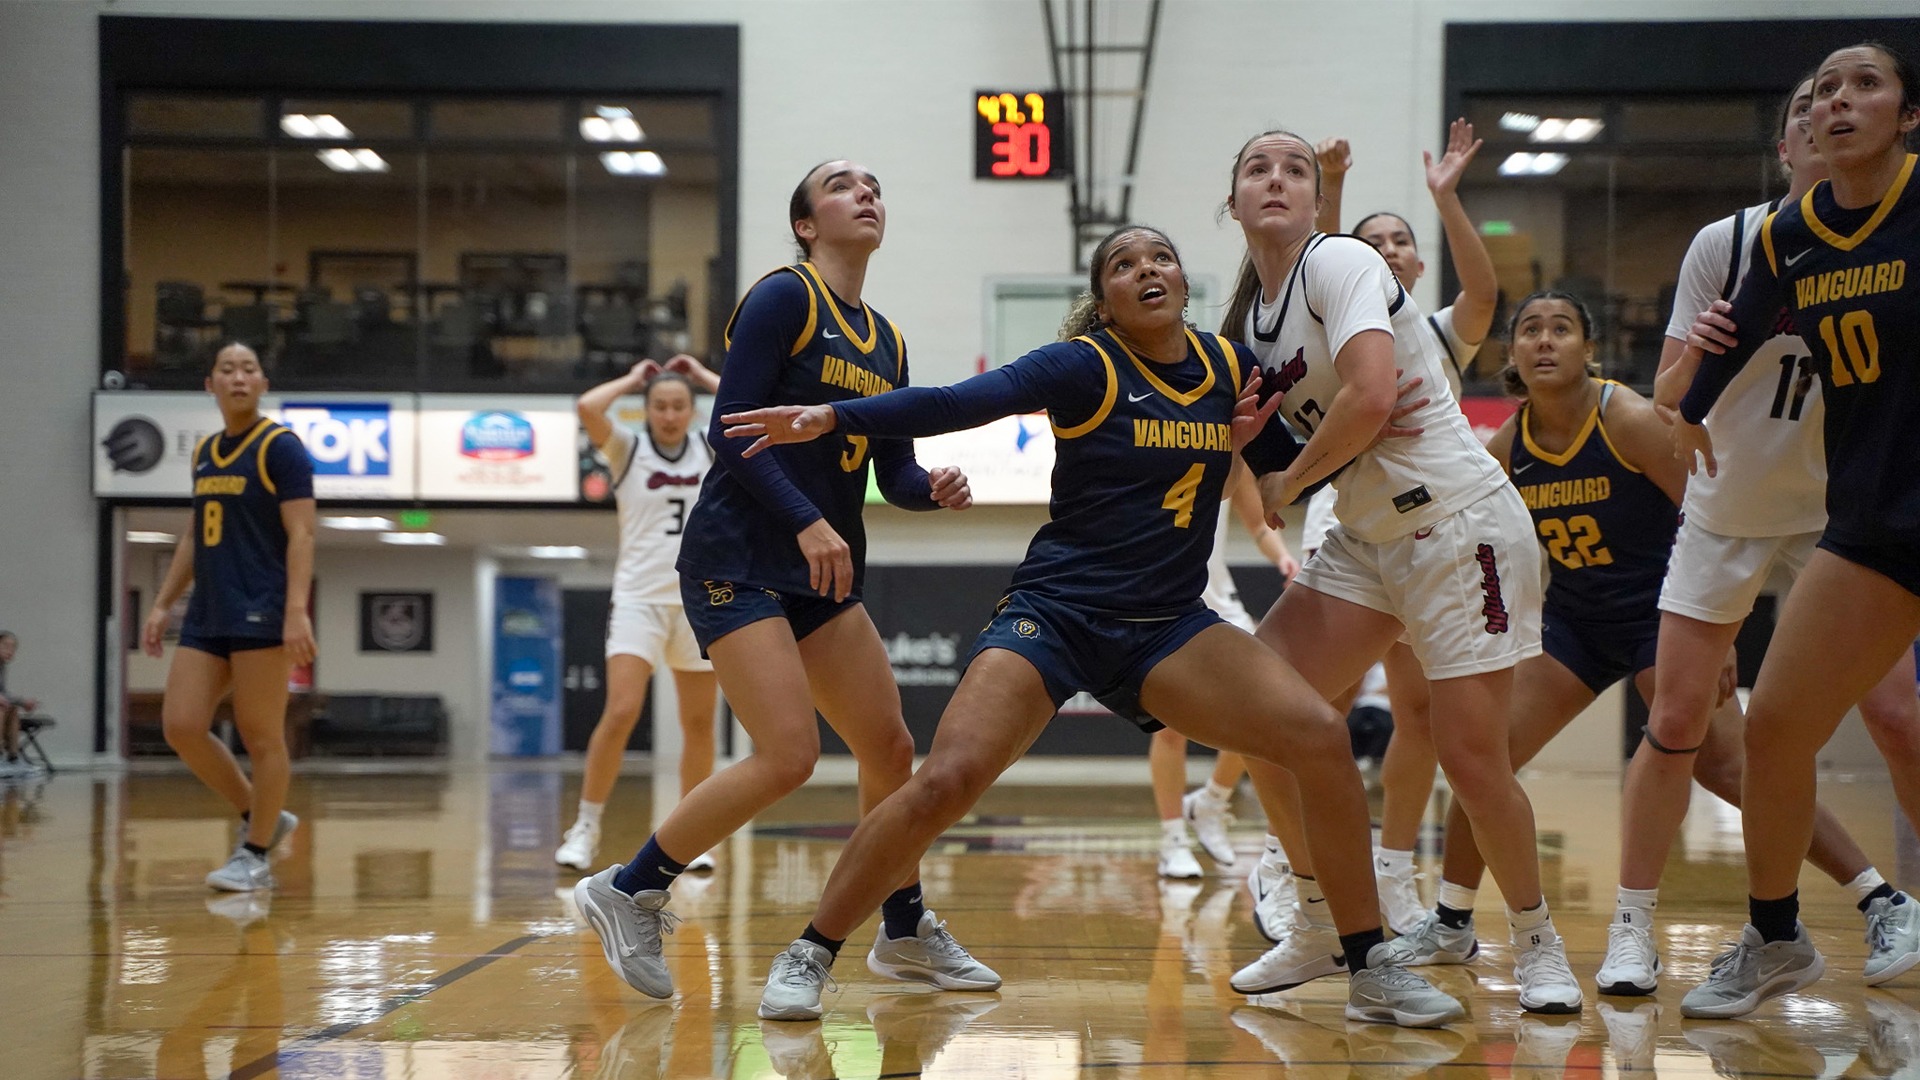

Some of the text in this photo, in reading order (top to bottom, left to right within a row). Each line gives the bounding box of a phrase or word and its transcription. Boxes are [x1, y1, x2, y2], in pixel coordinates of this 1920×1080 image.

[978, 92, 1044, 124] 47.7
[991, 122, 1050, 175] 30
[1795, 259, 1906, 310] VANGUARD
[1819, 309, 1881, 388] 10
[1770, 354, 1813, 421] 11
[664, 498, 685, 535] 3
[1161, 462, 1206, 529] 4
[1520, 476, 1610, 510] VANGUARD
[203, 500, 223, 547] 8
[1538, 514, 1614, 570] 22
[1475, 543, 1508, 634] Wildcats
[883, 631, 959, 666] uke's
